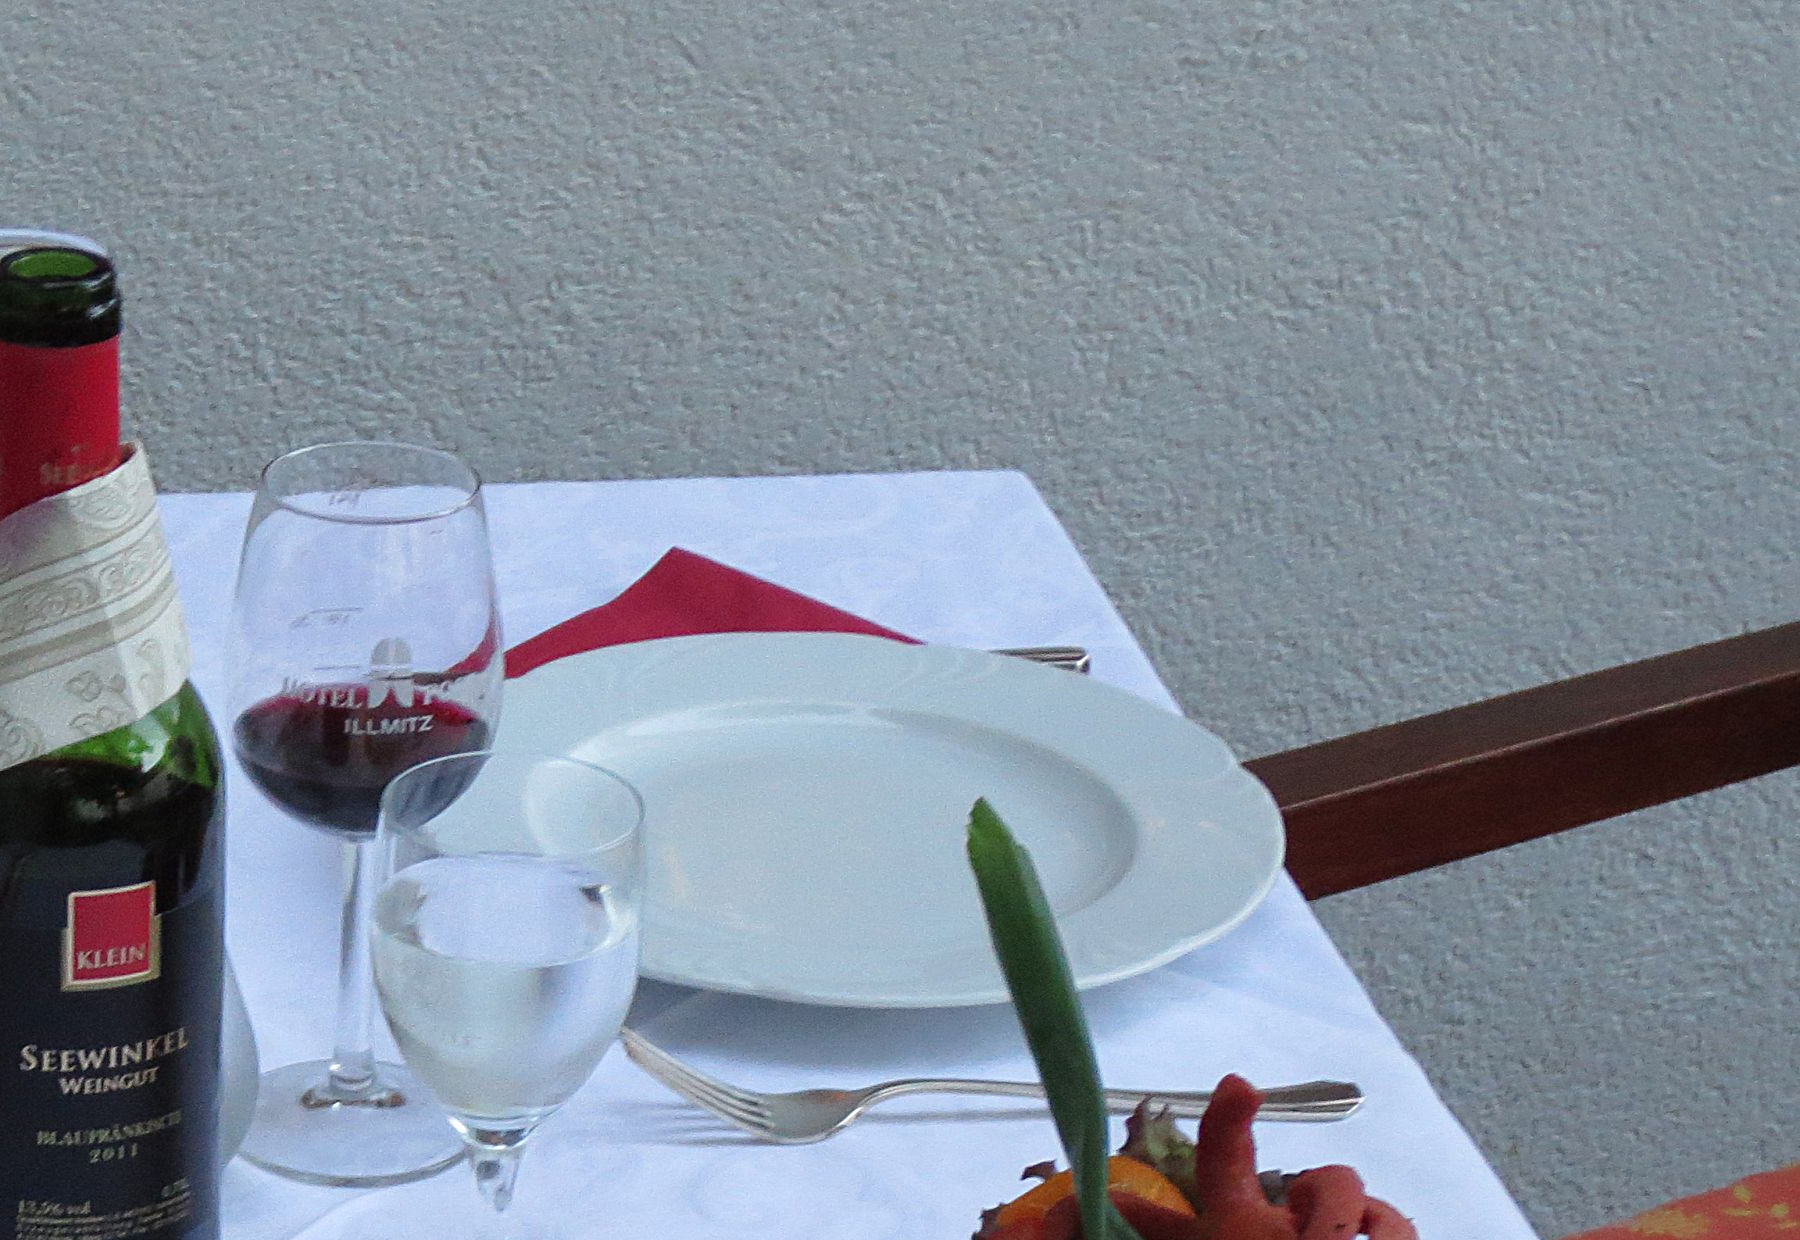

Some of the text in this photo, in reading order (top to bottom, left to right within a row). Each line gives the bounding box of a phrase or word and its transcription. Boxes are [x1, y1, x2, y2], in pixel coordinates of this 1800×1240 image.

[343, 714, 434, 736] ILLMITZ
[77, 943, 146, 970] KLEIN
[19, 1027, 190, 1073] SEEWINKEL
[59, 1066, 160, 1096] WEINGUT
[89, 1142, 138, 1164] 2011
